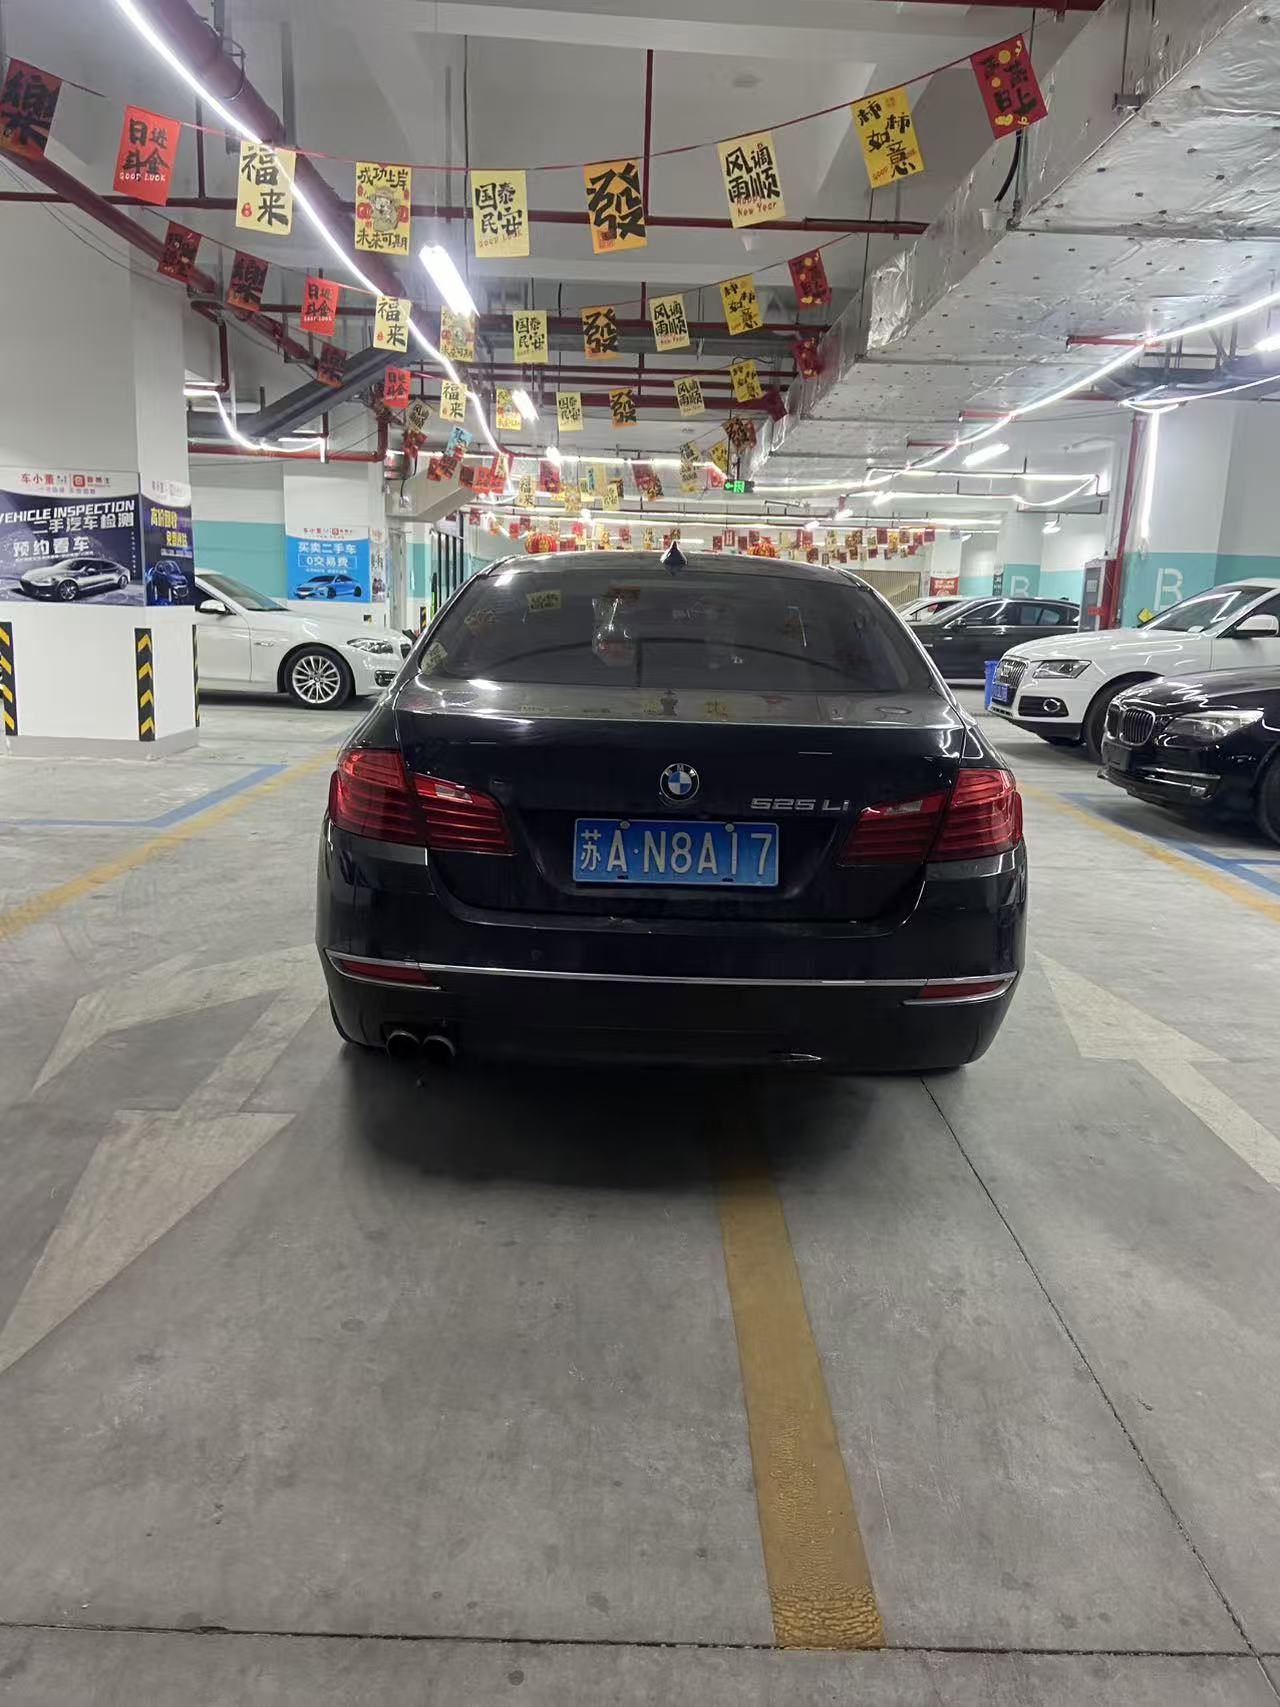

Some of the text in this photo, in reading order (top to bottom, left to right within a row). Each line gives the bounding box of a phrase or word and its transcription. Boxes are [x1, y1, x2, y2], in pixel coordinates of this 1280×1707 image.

[725, 146, 773, 177] 风调
[866, 129, 916, 178] 如意
[357, 166, 409, 191] 成功上岸
[727, 166, 781, 203] 雨顺
[474, 181, 517, 212] 国泰
[757, 201, 777, 212] Year
[481, 206, 523, 236] 民安
[515, 317, 541, 334] 国泰
[519, 331, 545, 350] 民安
[0, 500, 135, 523] VEHICLE INSPECTION
[32, 511, 134, 534] 二手汽车检测
[751, 798, 849, 811] 525 Li
